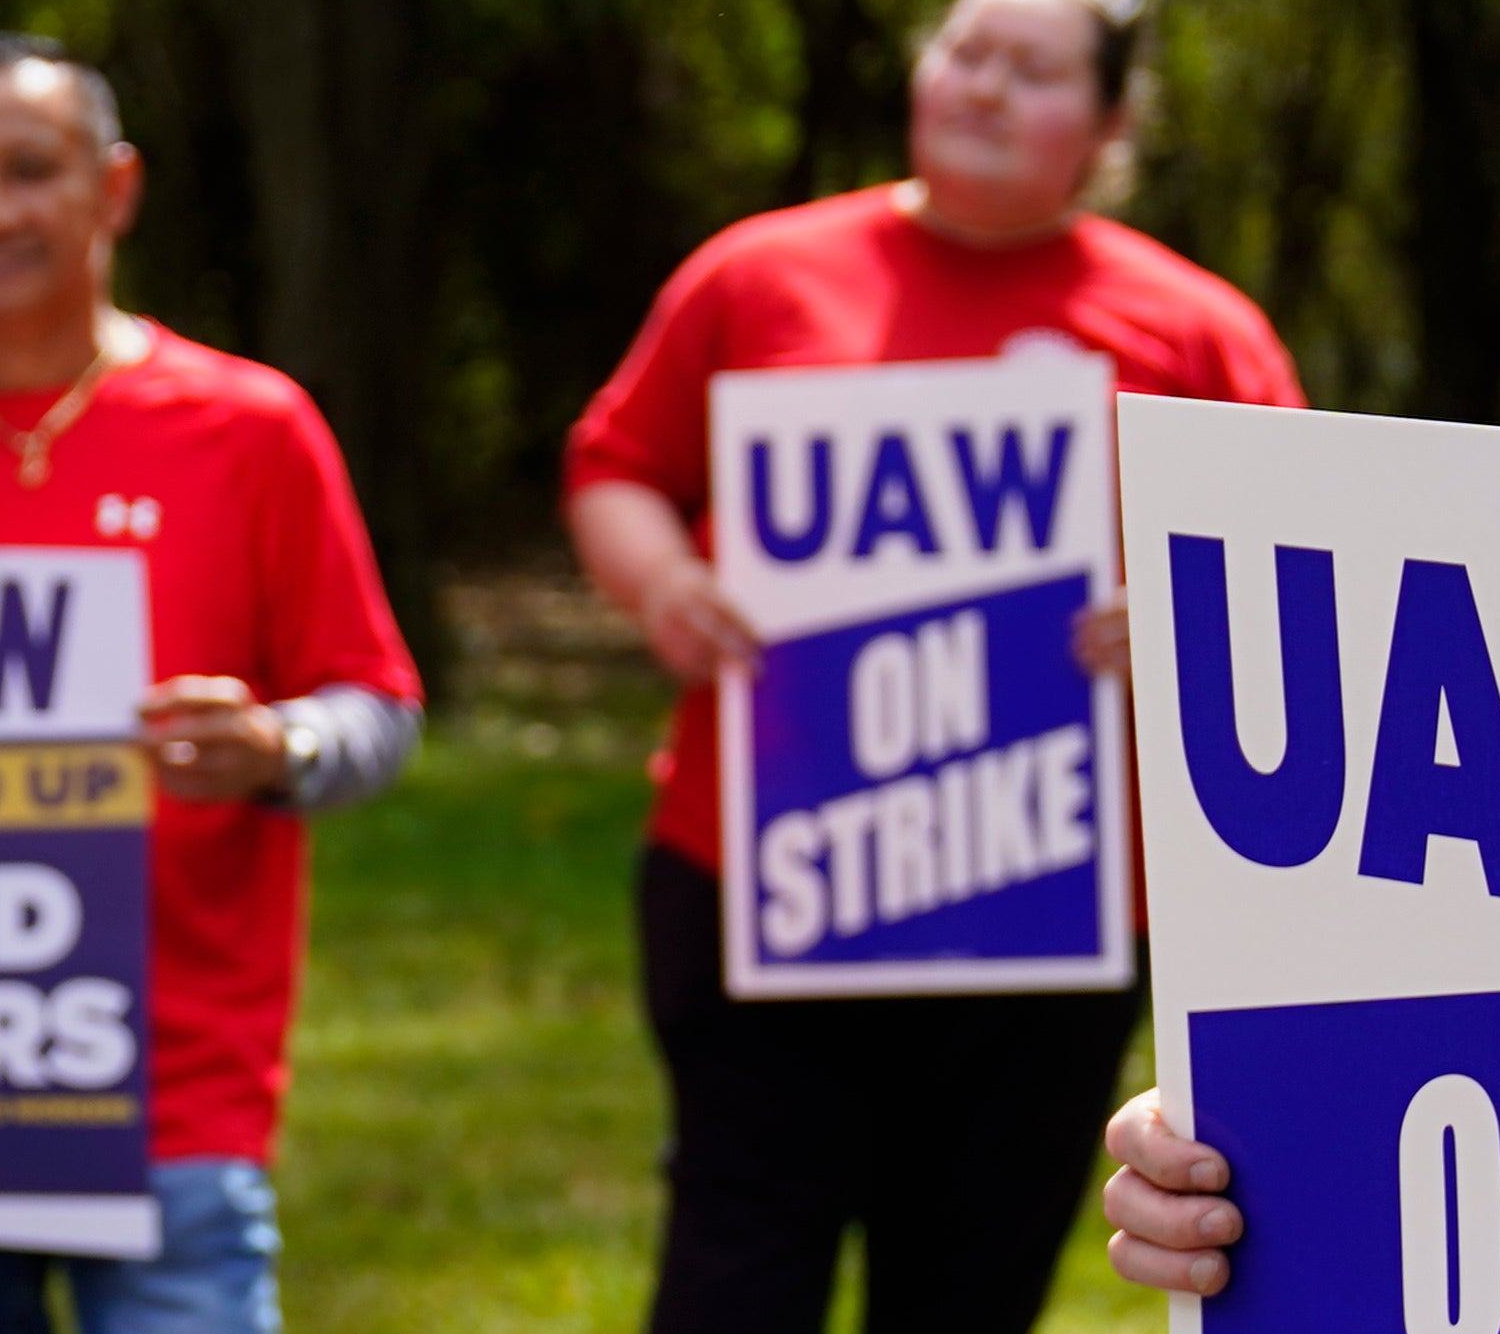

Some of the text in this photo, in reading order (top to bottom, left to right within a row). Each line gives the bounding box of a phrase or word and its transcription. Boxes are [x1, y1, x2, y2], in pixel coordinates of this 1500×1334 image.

[746, 422, 1075, 564] UAW
[848, 609, 989, 780] ON
[29, 763, 120, 807] UP
[759, 723, 1092, 956] STRIKE
